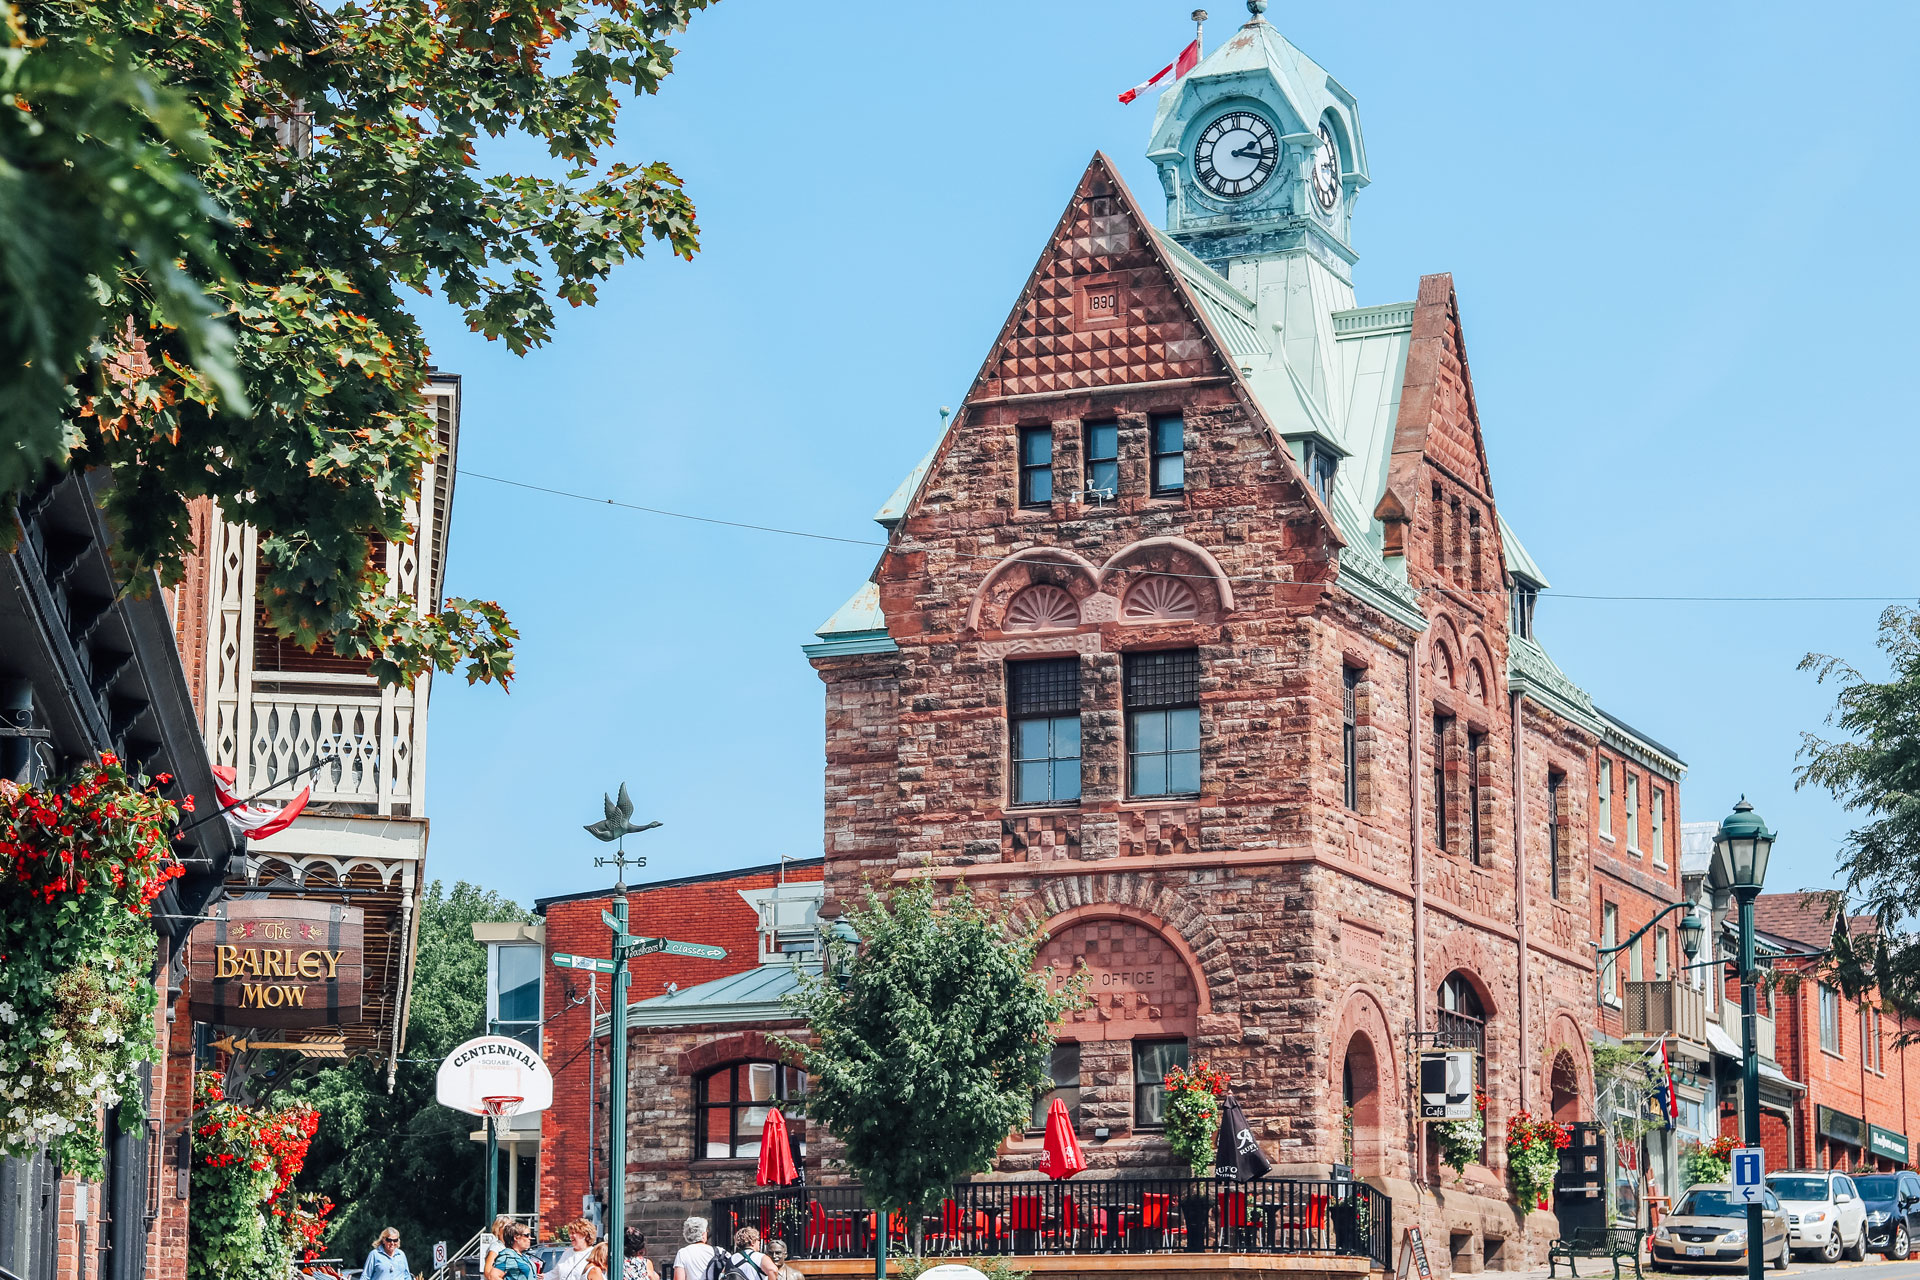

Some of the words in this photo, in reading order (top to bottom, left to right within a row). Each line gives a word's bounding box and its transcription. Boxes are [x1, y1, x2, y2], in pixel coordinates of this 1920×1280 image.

[1090, 295, 1114, 310] 1890
[594, 857, 604, 867] N
[638, 857, 647, 867] S
[259, 921, 292, 940] The
[672, 944, 705, 956] Classes
[215, 945, 344, 978] BARLEY
[1102, 971, 1155, 986] OFFICE
[238, 983, 308, 1009] MOW
[453, 1044, 537, 1071] CENTENNIAL
[1425, 1106, 1444, 1117] Café
